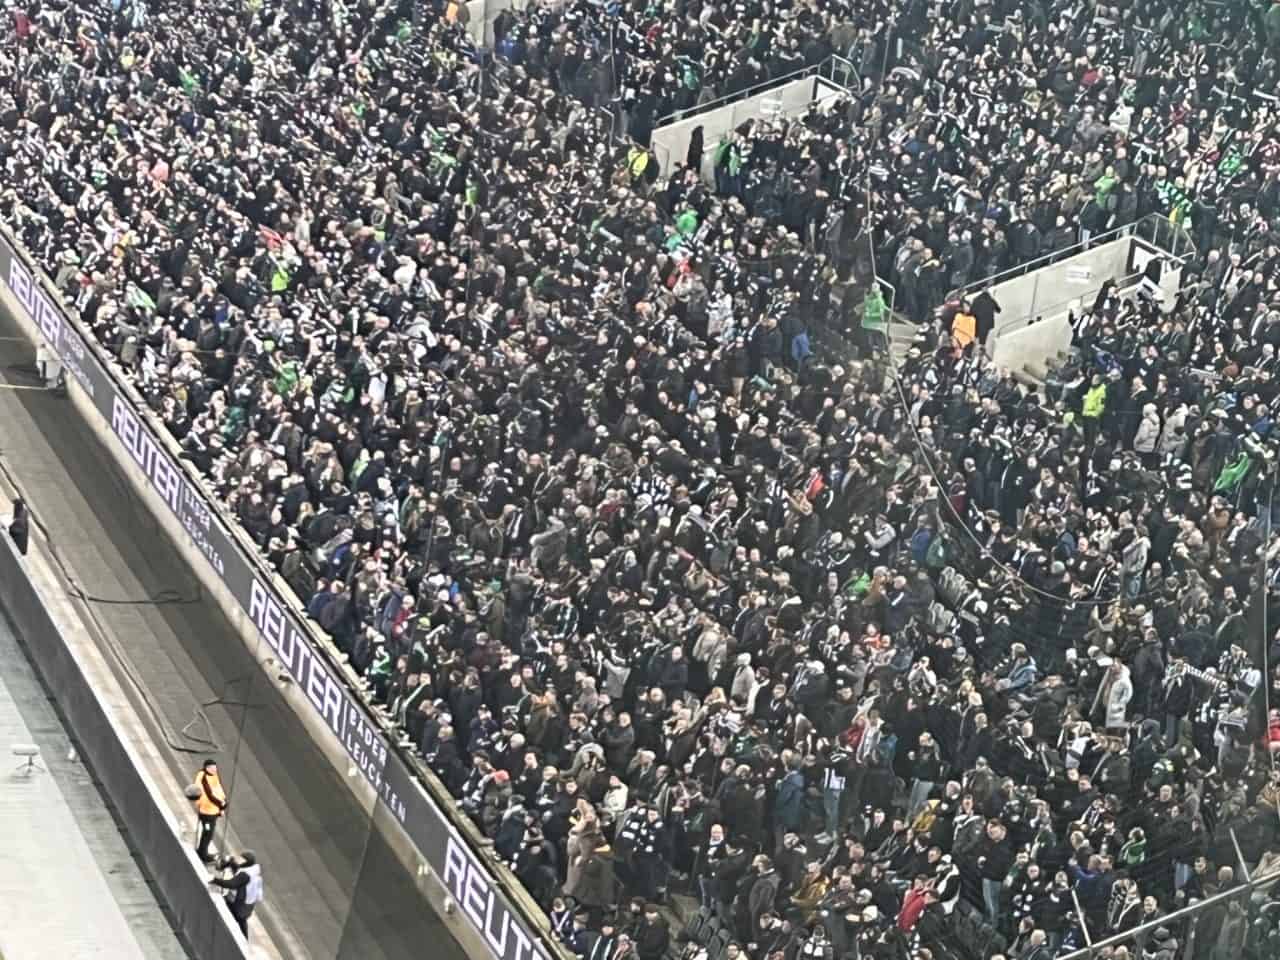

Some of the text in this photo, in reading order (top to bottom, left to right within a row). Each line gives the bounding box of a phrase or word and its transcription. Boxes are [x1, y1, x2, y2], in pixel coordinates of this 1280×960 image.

[9, 257, 61, 351] REUTER
[112, 395, 181, 512] REUTER
[249, 578, 343, 734] REUTER
[346, 733, 407, 825] LEUCHTEN
[350, 704, 388, 768] BÄDER
